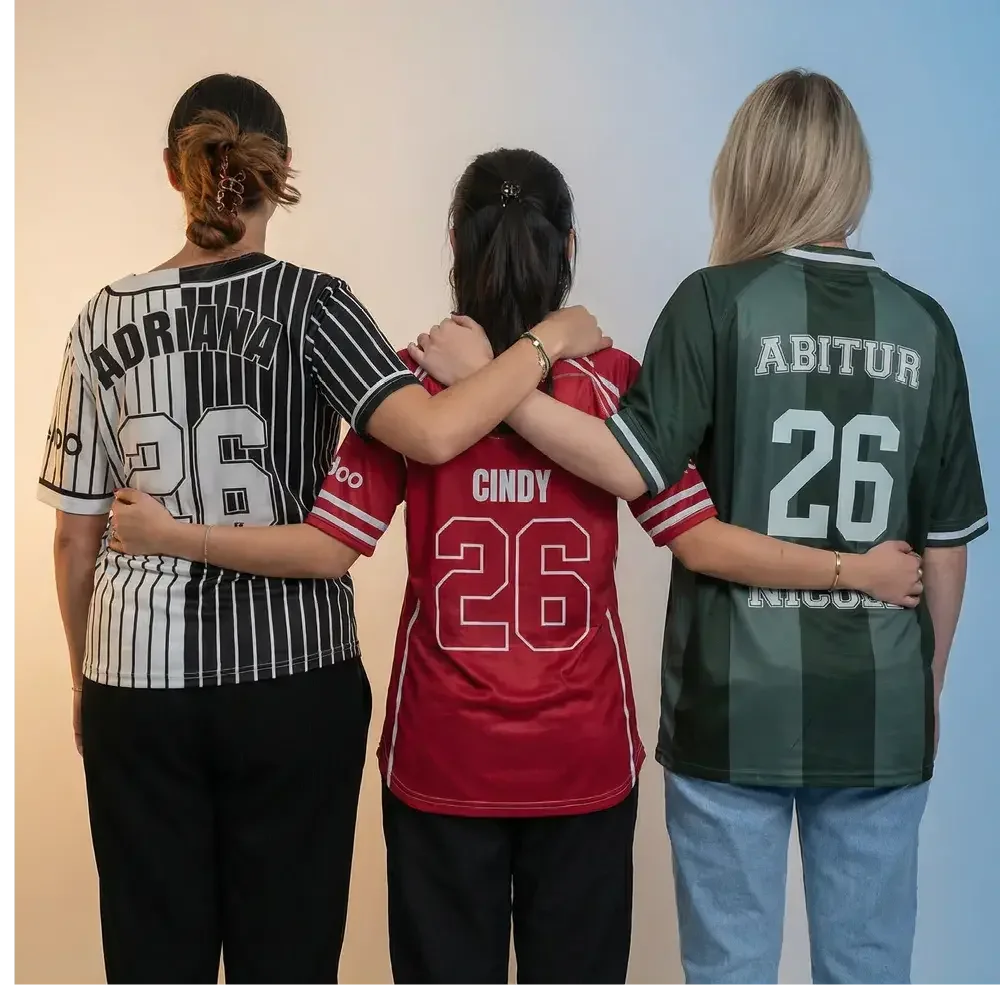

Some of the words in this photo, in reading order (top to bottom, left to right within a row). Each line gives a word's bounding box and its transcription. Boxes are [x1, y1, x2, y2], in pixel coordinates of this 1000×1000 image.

[90, 304, 283, 390] ADRIANA
[754, 334, 922, 389] ABITUR
[472, 468, 551, 503] CINDY
[767, 408, 900, 542] 26
[435, 516, 590, 651] 26
